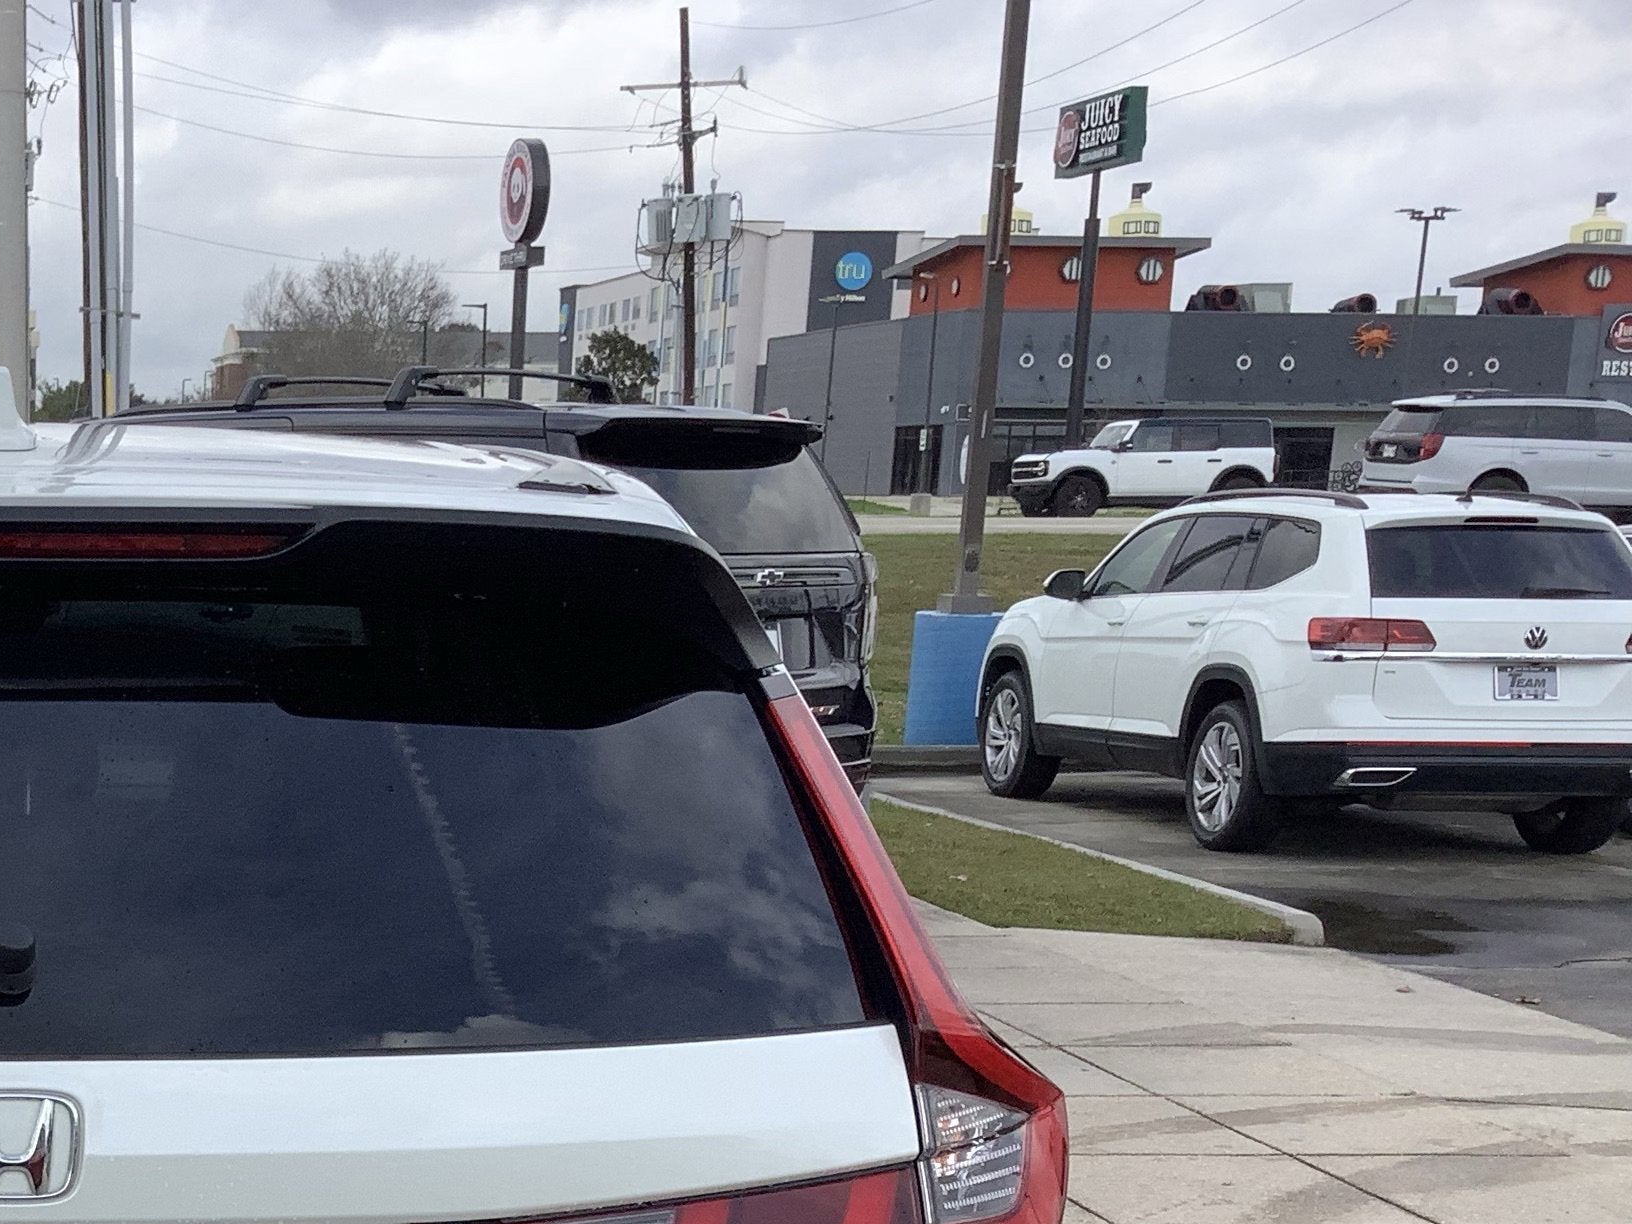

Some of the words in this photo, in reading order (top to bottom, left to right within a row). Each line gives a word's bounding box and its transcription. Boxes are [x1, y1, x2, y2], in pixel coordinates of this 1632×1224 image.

[1081, 94, 1123, 131] JUICY
[1079, 123, 1120, 150] SEAFOOD
[838, 260, 866, 280] tru
[1601, 360, 1632, 377] RES
[1508, 673, 1547, 689] TEAM
